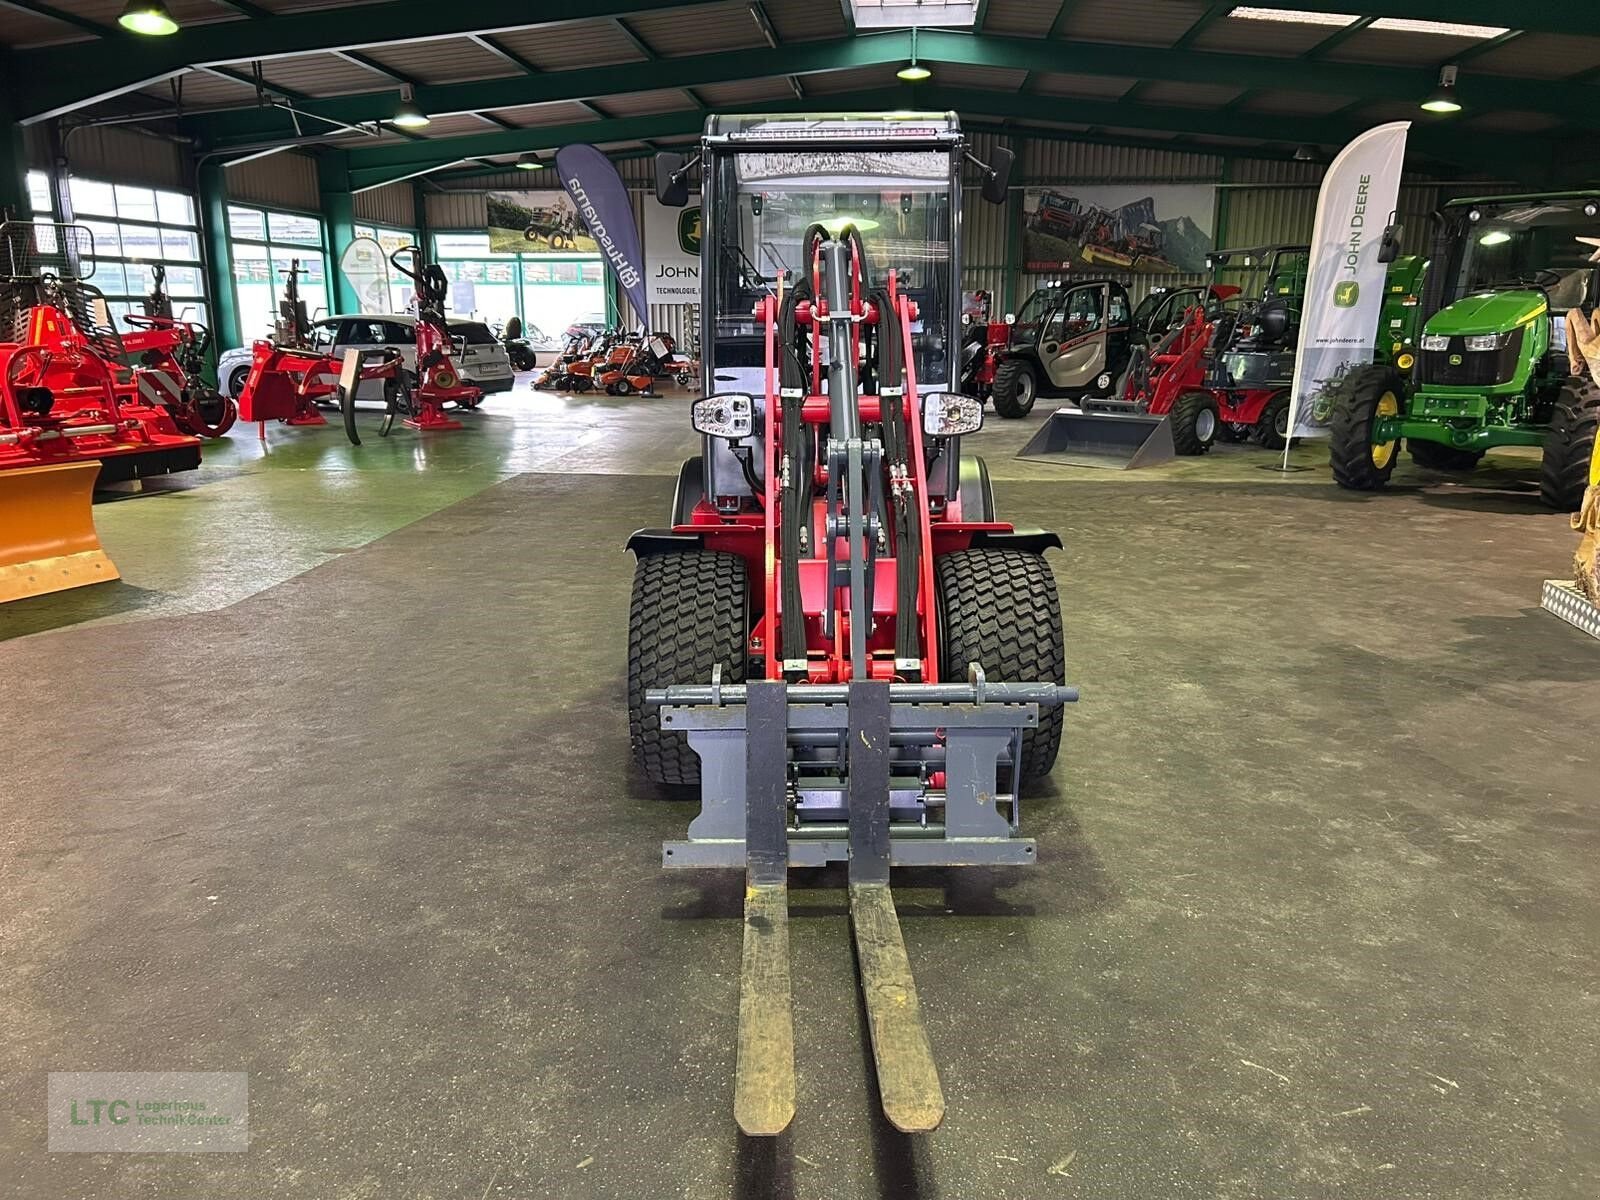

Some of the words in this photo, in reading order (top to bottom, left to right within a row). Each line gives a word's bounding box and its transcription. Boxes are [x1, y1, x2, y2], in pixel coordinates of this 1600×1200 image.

[1351, 174, 1371, 228] DEERE
[1344, 231, 1362, 275] JOHN
[656, 264, 698, 278] JOHN
[656, 287, 698, 295] TECHNOLOGIE,
[1315, 337, 1364, 345] www.johndeere.at
[1099, 376, 1108, 387] 25
